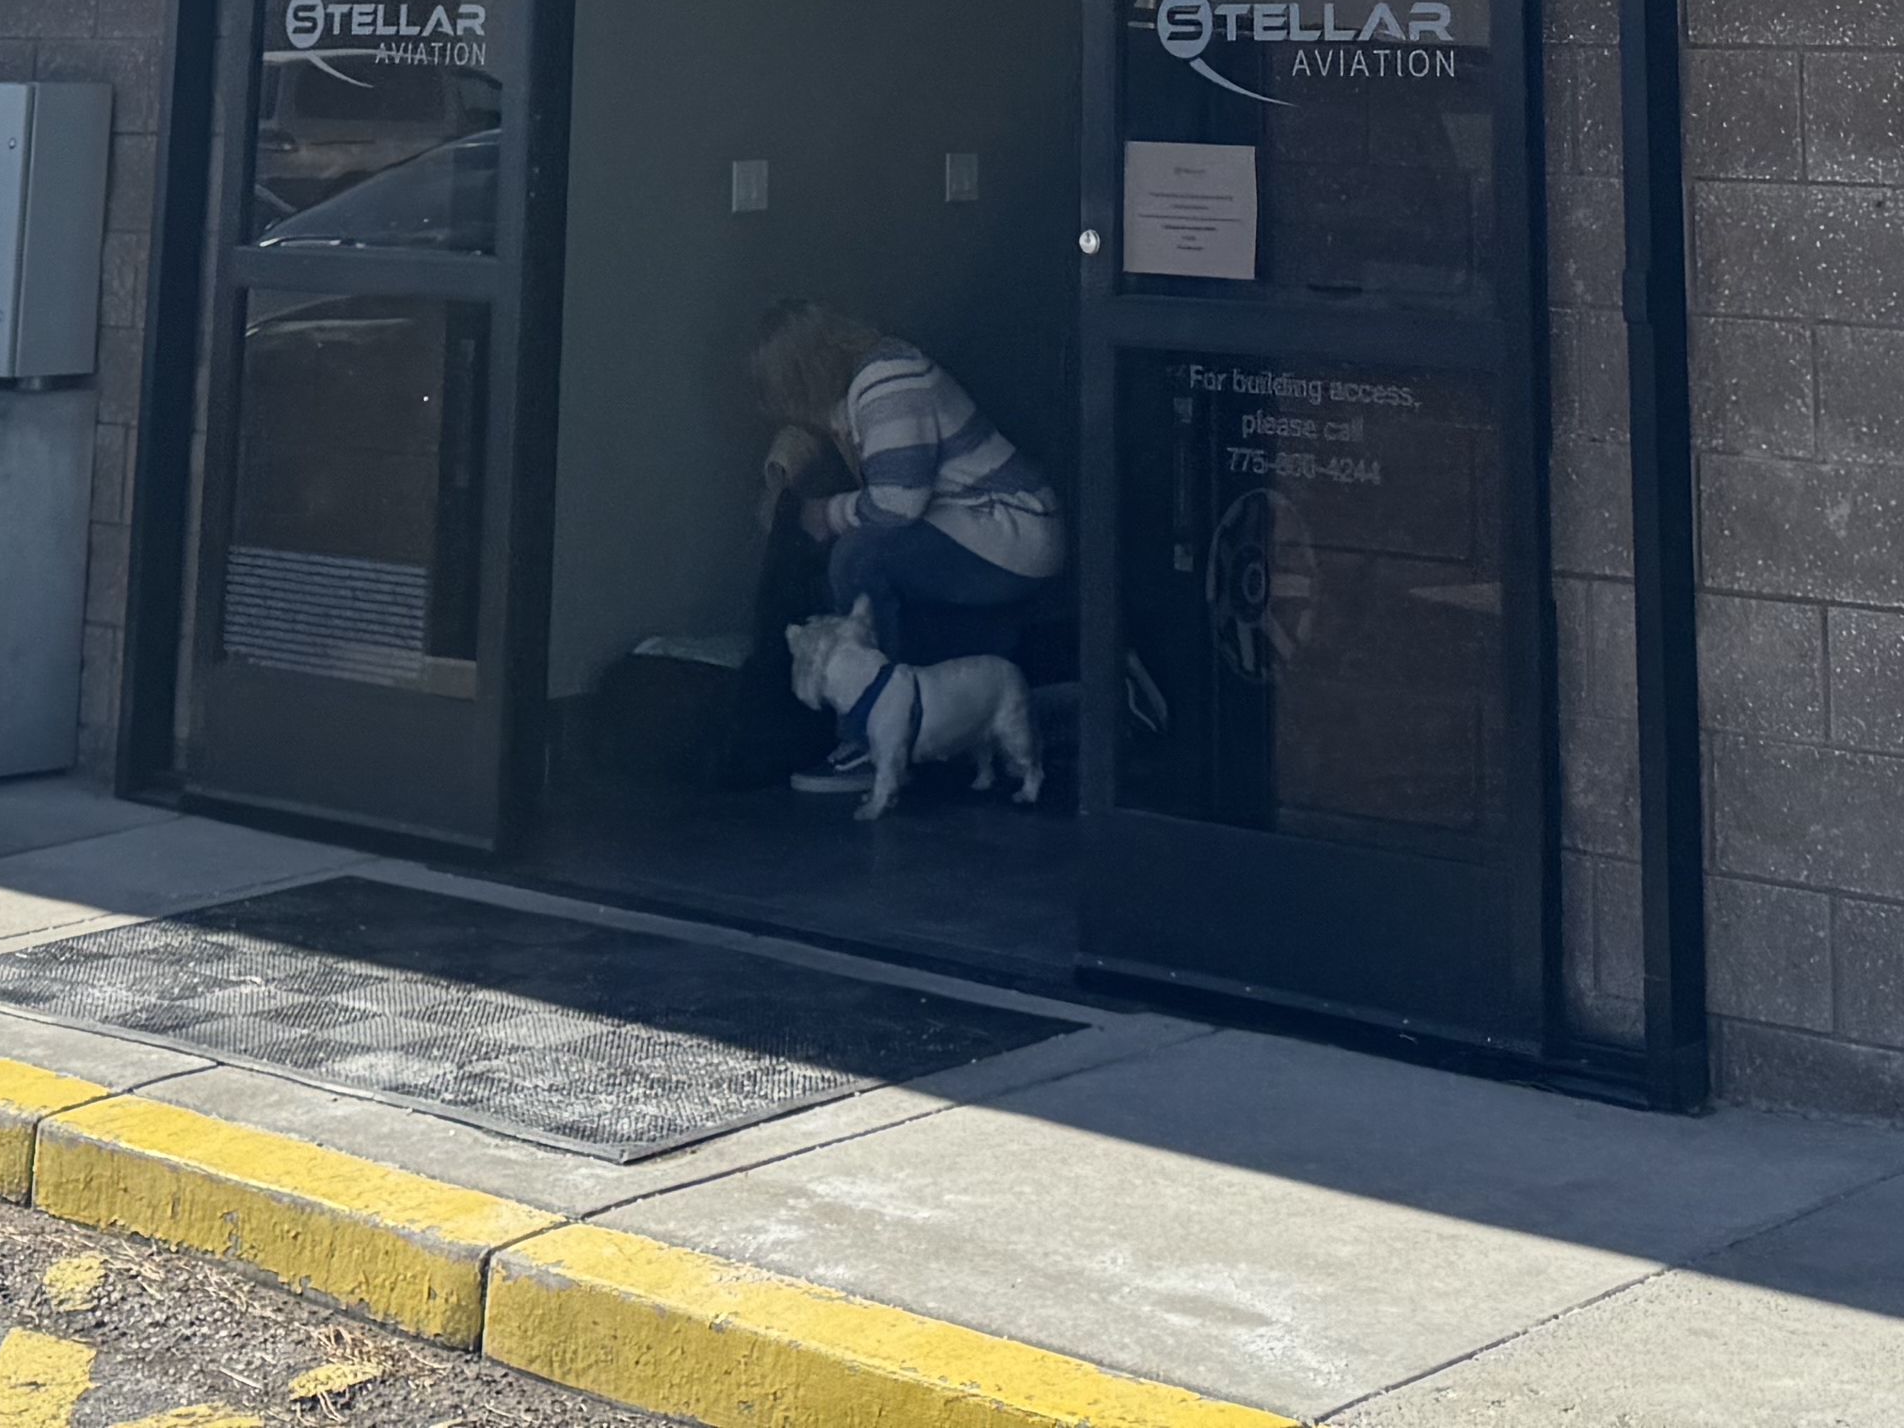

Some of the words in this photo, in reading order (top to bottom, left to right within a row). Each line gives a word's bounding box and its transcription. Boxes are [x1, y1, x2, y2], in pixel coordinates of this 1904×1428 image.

[289, 1, 486, 38] STELLAR
[1162, 0, 1455, 43] STELLAR
[375, 42, 486, 66] AVIATION
[1292, 48, 1456, 78] AVIATION
[1189, 365, 1227, 391] For
[1233, 369, 1322, 405] building
[1329, 381, 1423, 412] access,
[1241, 409, 1318, 438] please
[1323, 415, 1364, 442] call
